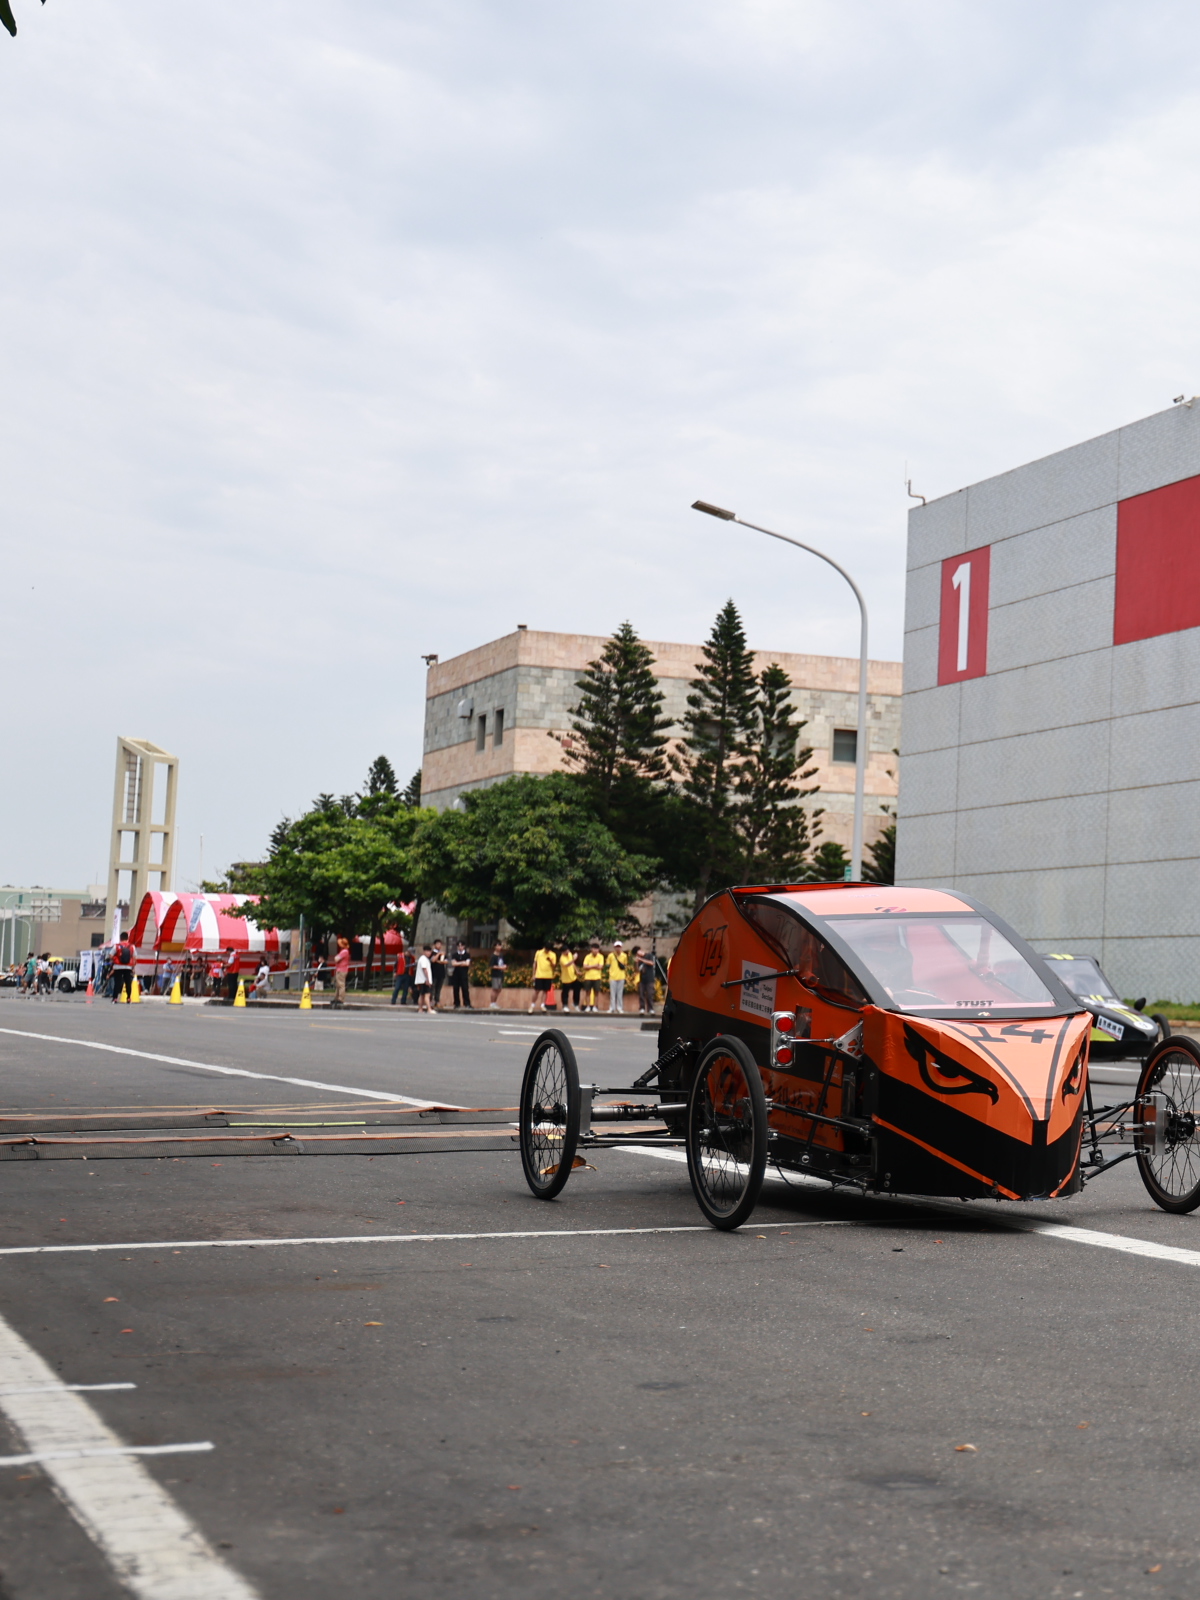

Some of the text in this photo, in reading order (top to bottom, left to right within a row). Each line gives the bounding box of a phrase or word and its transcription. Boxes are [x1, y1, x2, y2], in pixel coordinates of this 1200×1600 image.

[951, 561, 972, 671] 1
[699, 924, 728, 977] 14
[959, 1022, 1055, 1044] 14
